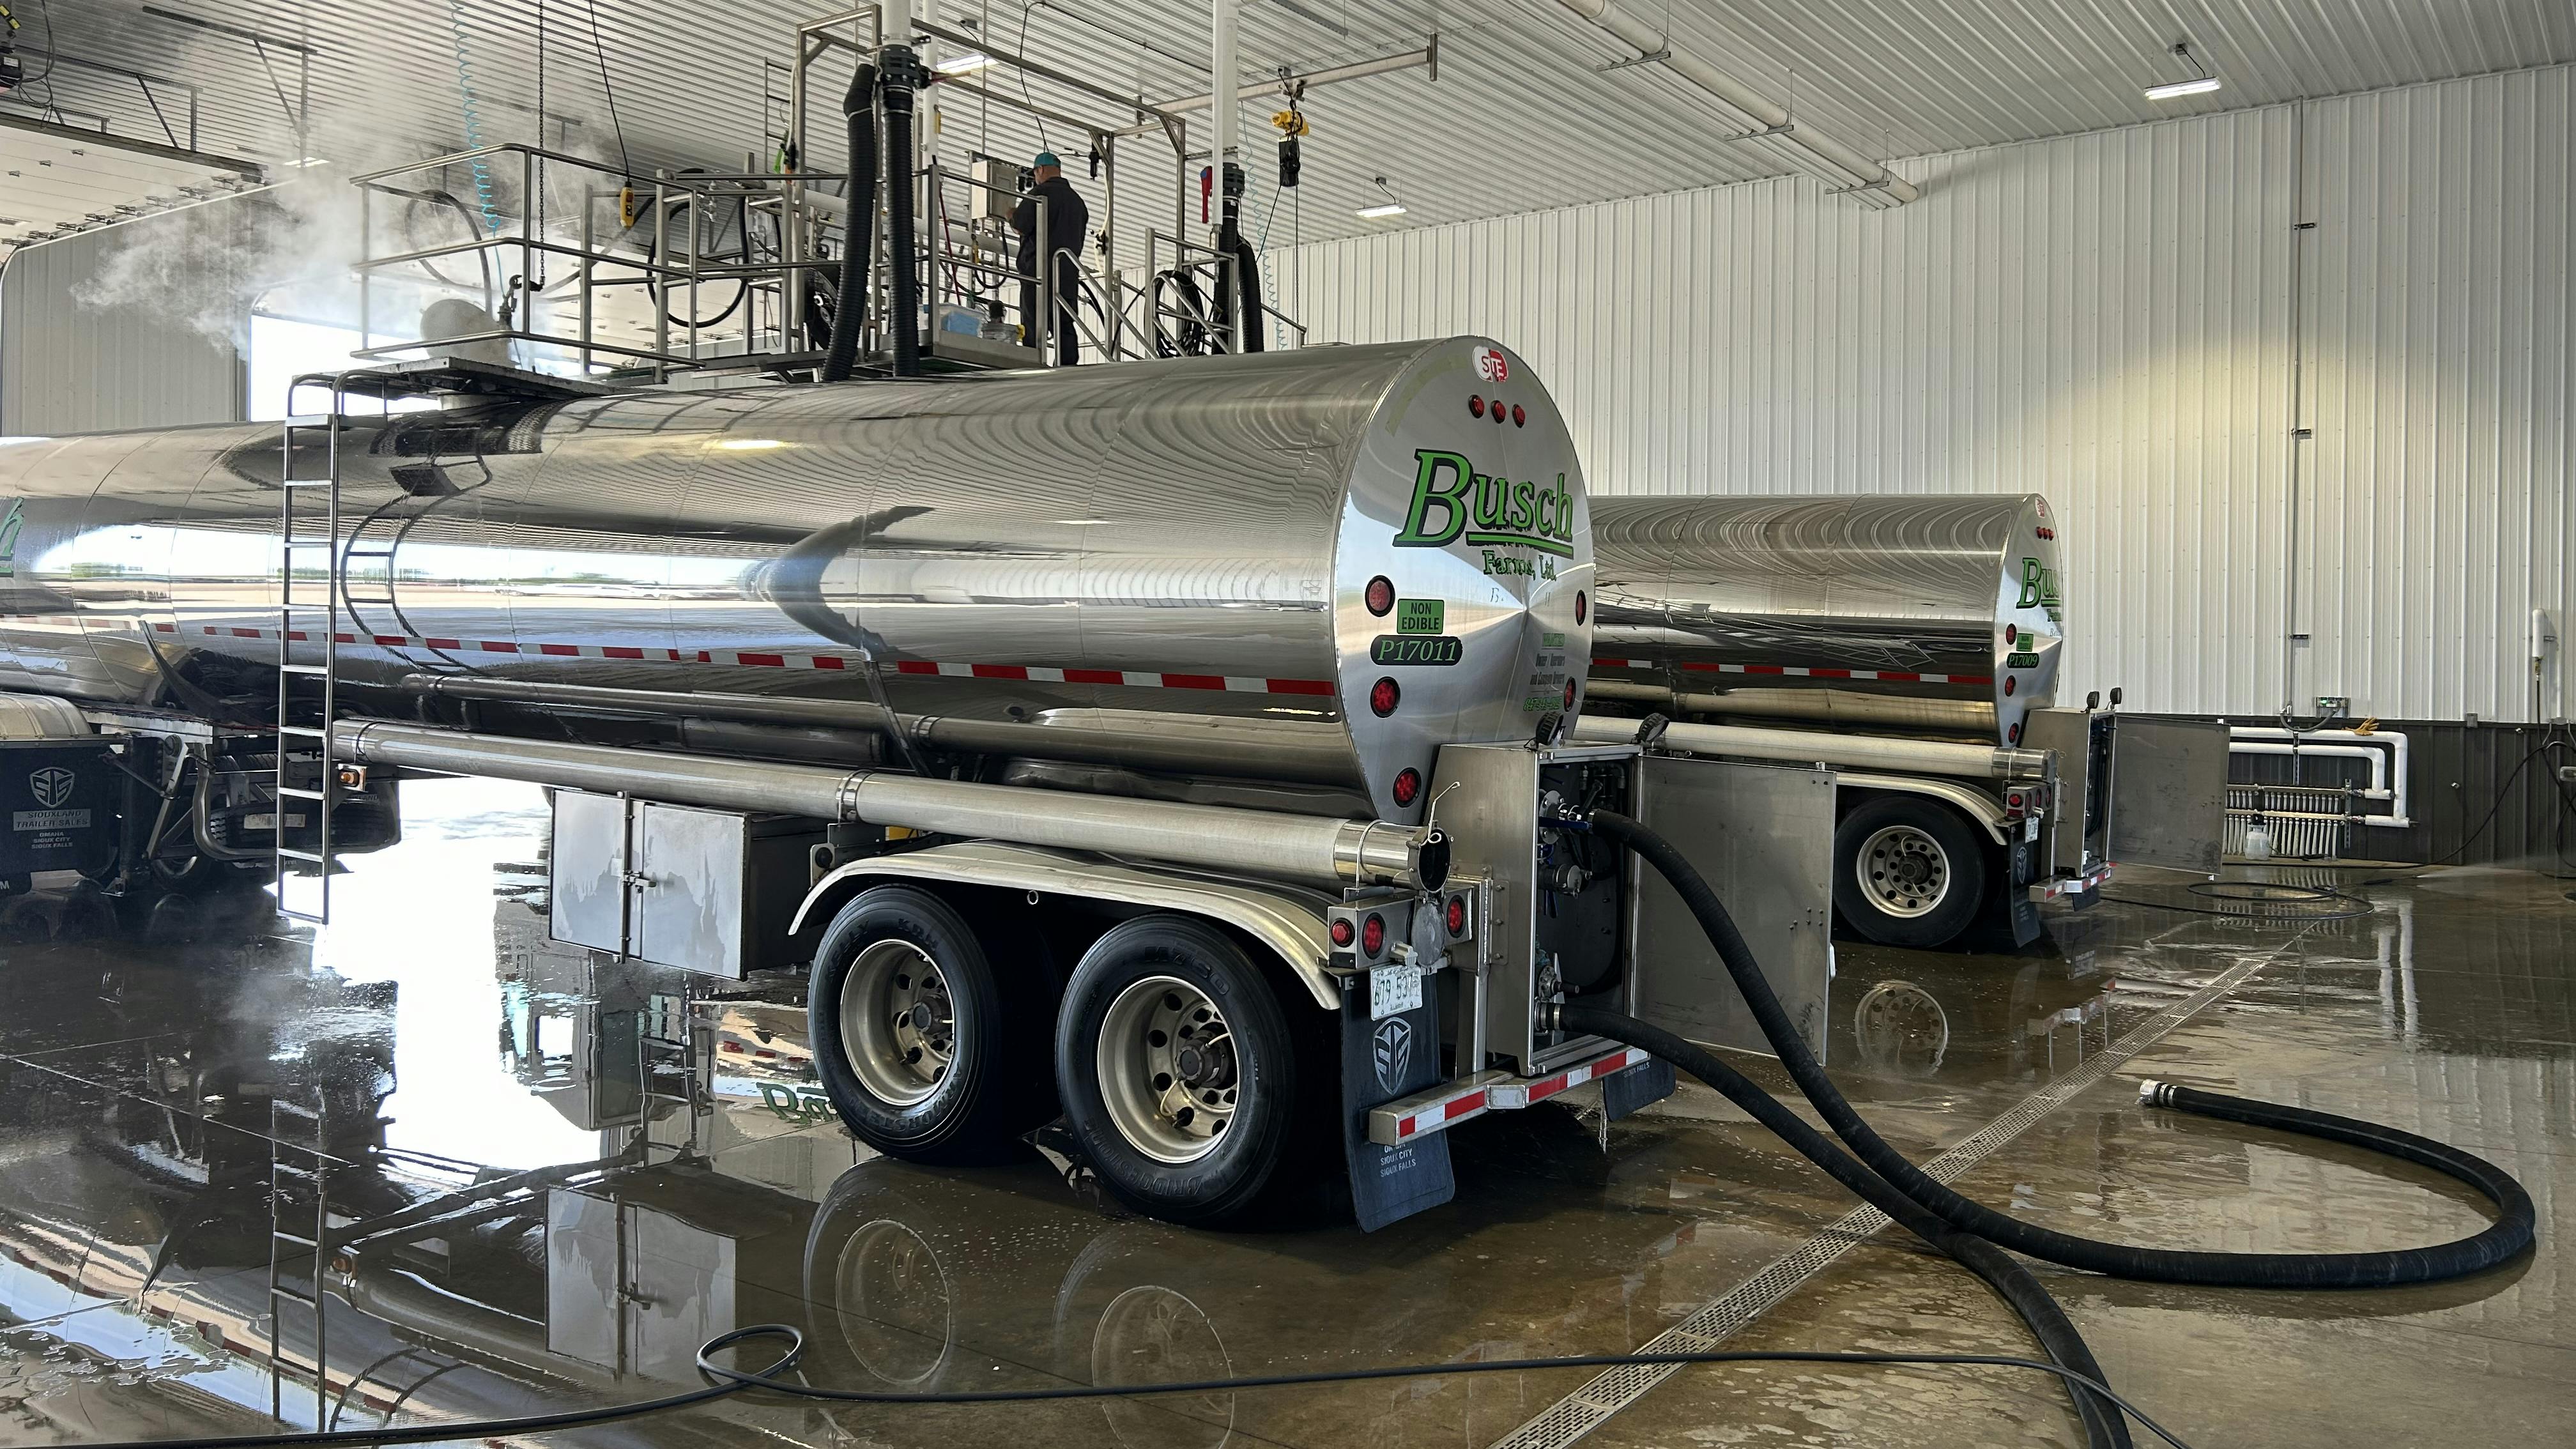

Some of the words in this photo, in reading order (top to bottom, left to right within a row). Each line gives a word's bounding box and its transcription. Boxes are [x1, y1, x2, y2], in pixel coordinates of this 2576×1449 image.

[1392, 448, 1573, 548] Busch
[1411, 602, 1432, 615] NON
[1401, 618, 1440, 631] EDIBLE
[1377, 640, 1457, 662] P17011
[2008, 654, 2038, 666] P17009
[28, 810, 82, 818] SIOUXLAND
[58, 818, 88, 826] SALES
[1374, 979, 1391, 1006] 679
[1380, 1153, 1399, 1166] SIOUX
[1399, 1148, 1413, 1160] CITY
[1380, 1165, 1398, 1177] SIOUX
[1398, 1158, 1416, 1171] FALLS
